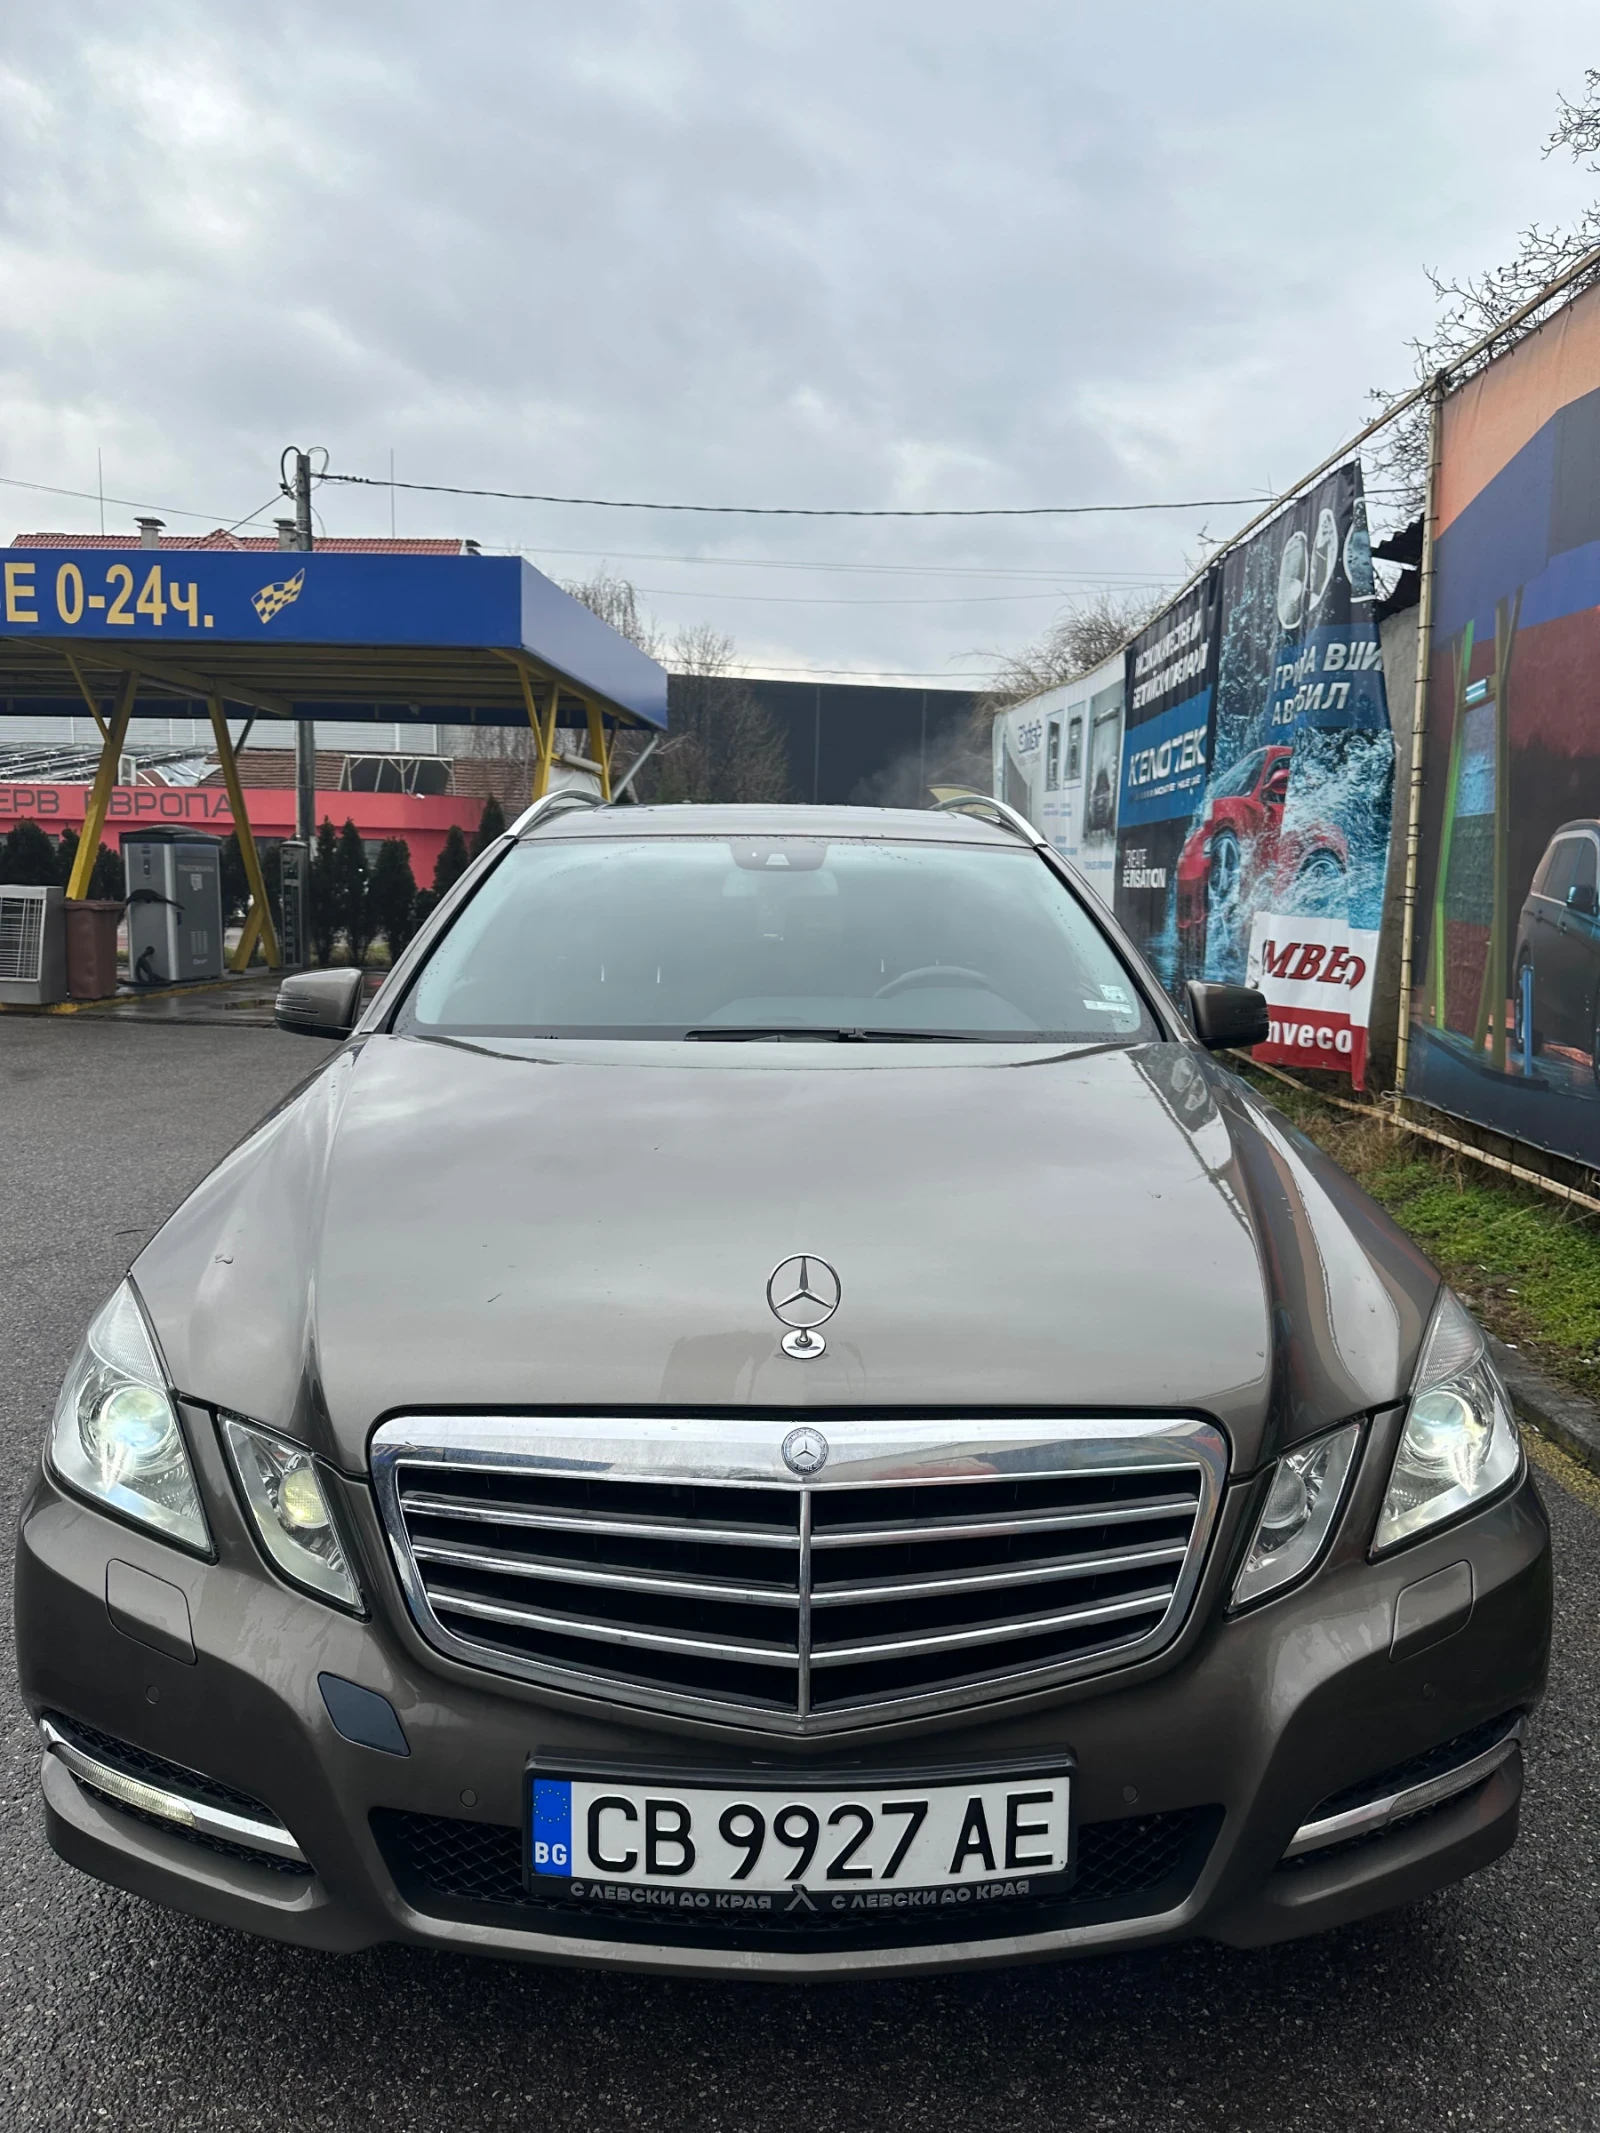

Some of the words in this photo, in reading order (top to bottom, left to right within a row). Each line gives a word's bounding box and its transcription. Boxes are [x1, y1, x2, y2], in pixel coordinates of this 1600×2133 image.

[56, 562, 214, 628] 0-24ч.
[1127, 725, 1208, 787] KENOTEK
[534, 1841, 568, 1866] BG
[586, 1795, 696, 1876] CB
[717, 1800, 930, 1881] 9927
[948, 1790, 1054, 1875] AE
[589, 1885, 675, 1905] ЛЕВСКИ
[678, 1891, 710, 1908] ДО
[715, 1893, 772, 1910] КРАЯ
[850, 1890, 937, 1910] ЛЕВСКИ
[940, 1886, 971, 1905] ДО
[976, 1880, 1030, 1900] КРАЯ
